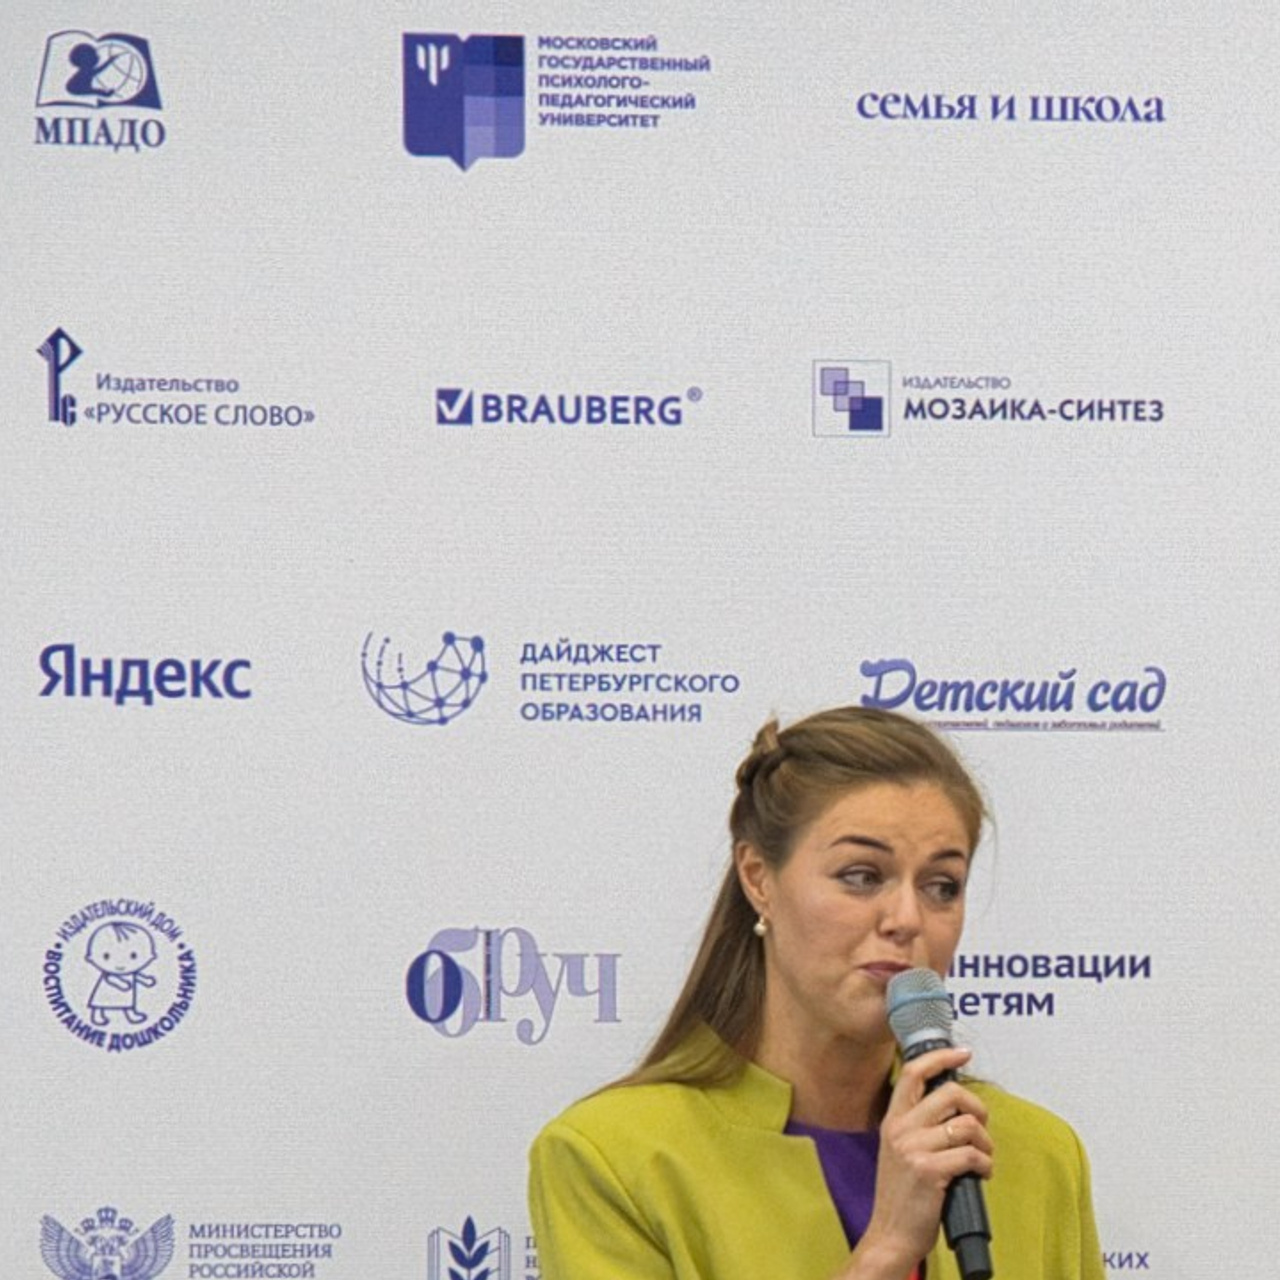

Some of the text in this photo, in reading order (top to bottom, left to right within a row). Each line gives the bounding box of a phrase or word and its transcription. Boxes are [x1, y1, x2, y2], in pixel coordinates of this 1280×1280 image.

[537, 34, 658, 52] МОСКОВСКИЙ
[537, 54, 712, 72] ГОСУДАРСТВЕННЫЙ
[537, 73, 650, 90] ПСИХОЛОГО-
[538, 92, 697, 110] ПЕДАГОГИЧЕСКИЙ
[856, 92, 1166, 123] семья и школа
[538, 112, 661, 129] УНИВЕРСИТЕТ
[34, 116, 166, 153] МПАДО
[95, 372, 240, 395] Издательство
[901, 375, 1012, 391] ИЗДАТЕЛЬСТВО
[83, 401, 316, 427] «РУССКОЕ СЛОВО»
[903, 397, 1164, 423] МОЗАИКА-СИНТЕЗ
[519, 637, 662, 666] ДАЙДЖЕСТ
[39, 643, 252, 707] Яндекс
[520, 672, 741, 694] ПЕТЕРБУРГСКОГО
[859, 658, 1167, 714] Детский сад
[519, 701, 702, 723] ОБРАЗОВАНИЯ
[56, 898, 184, 943] ИЗДАТЕЛЬСКИЙ ДОМ
[43, 949, 196, 1053] ВОСПИТАНИЕ ДОШКОЛЬНИКА
[188, 1223, 343, 1240] МИНИСТЕРСТВО
[188, 1242, 333, 1260] ПРОСВЕЩЕНИЯ
[188, 1260, 316, 1280] РОССИЙСКОЙ
